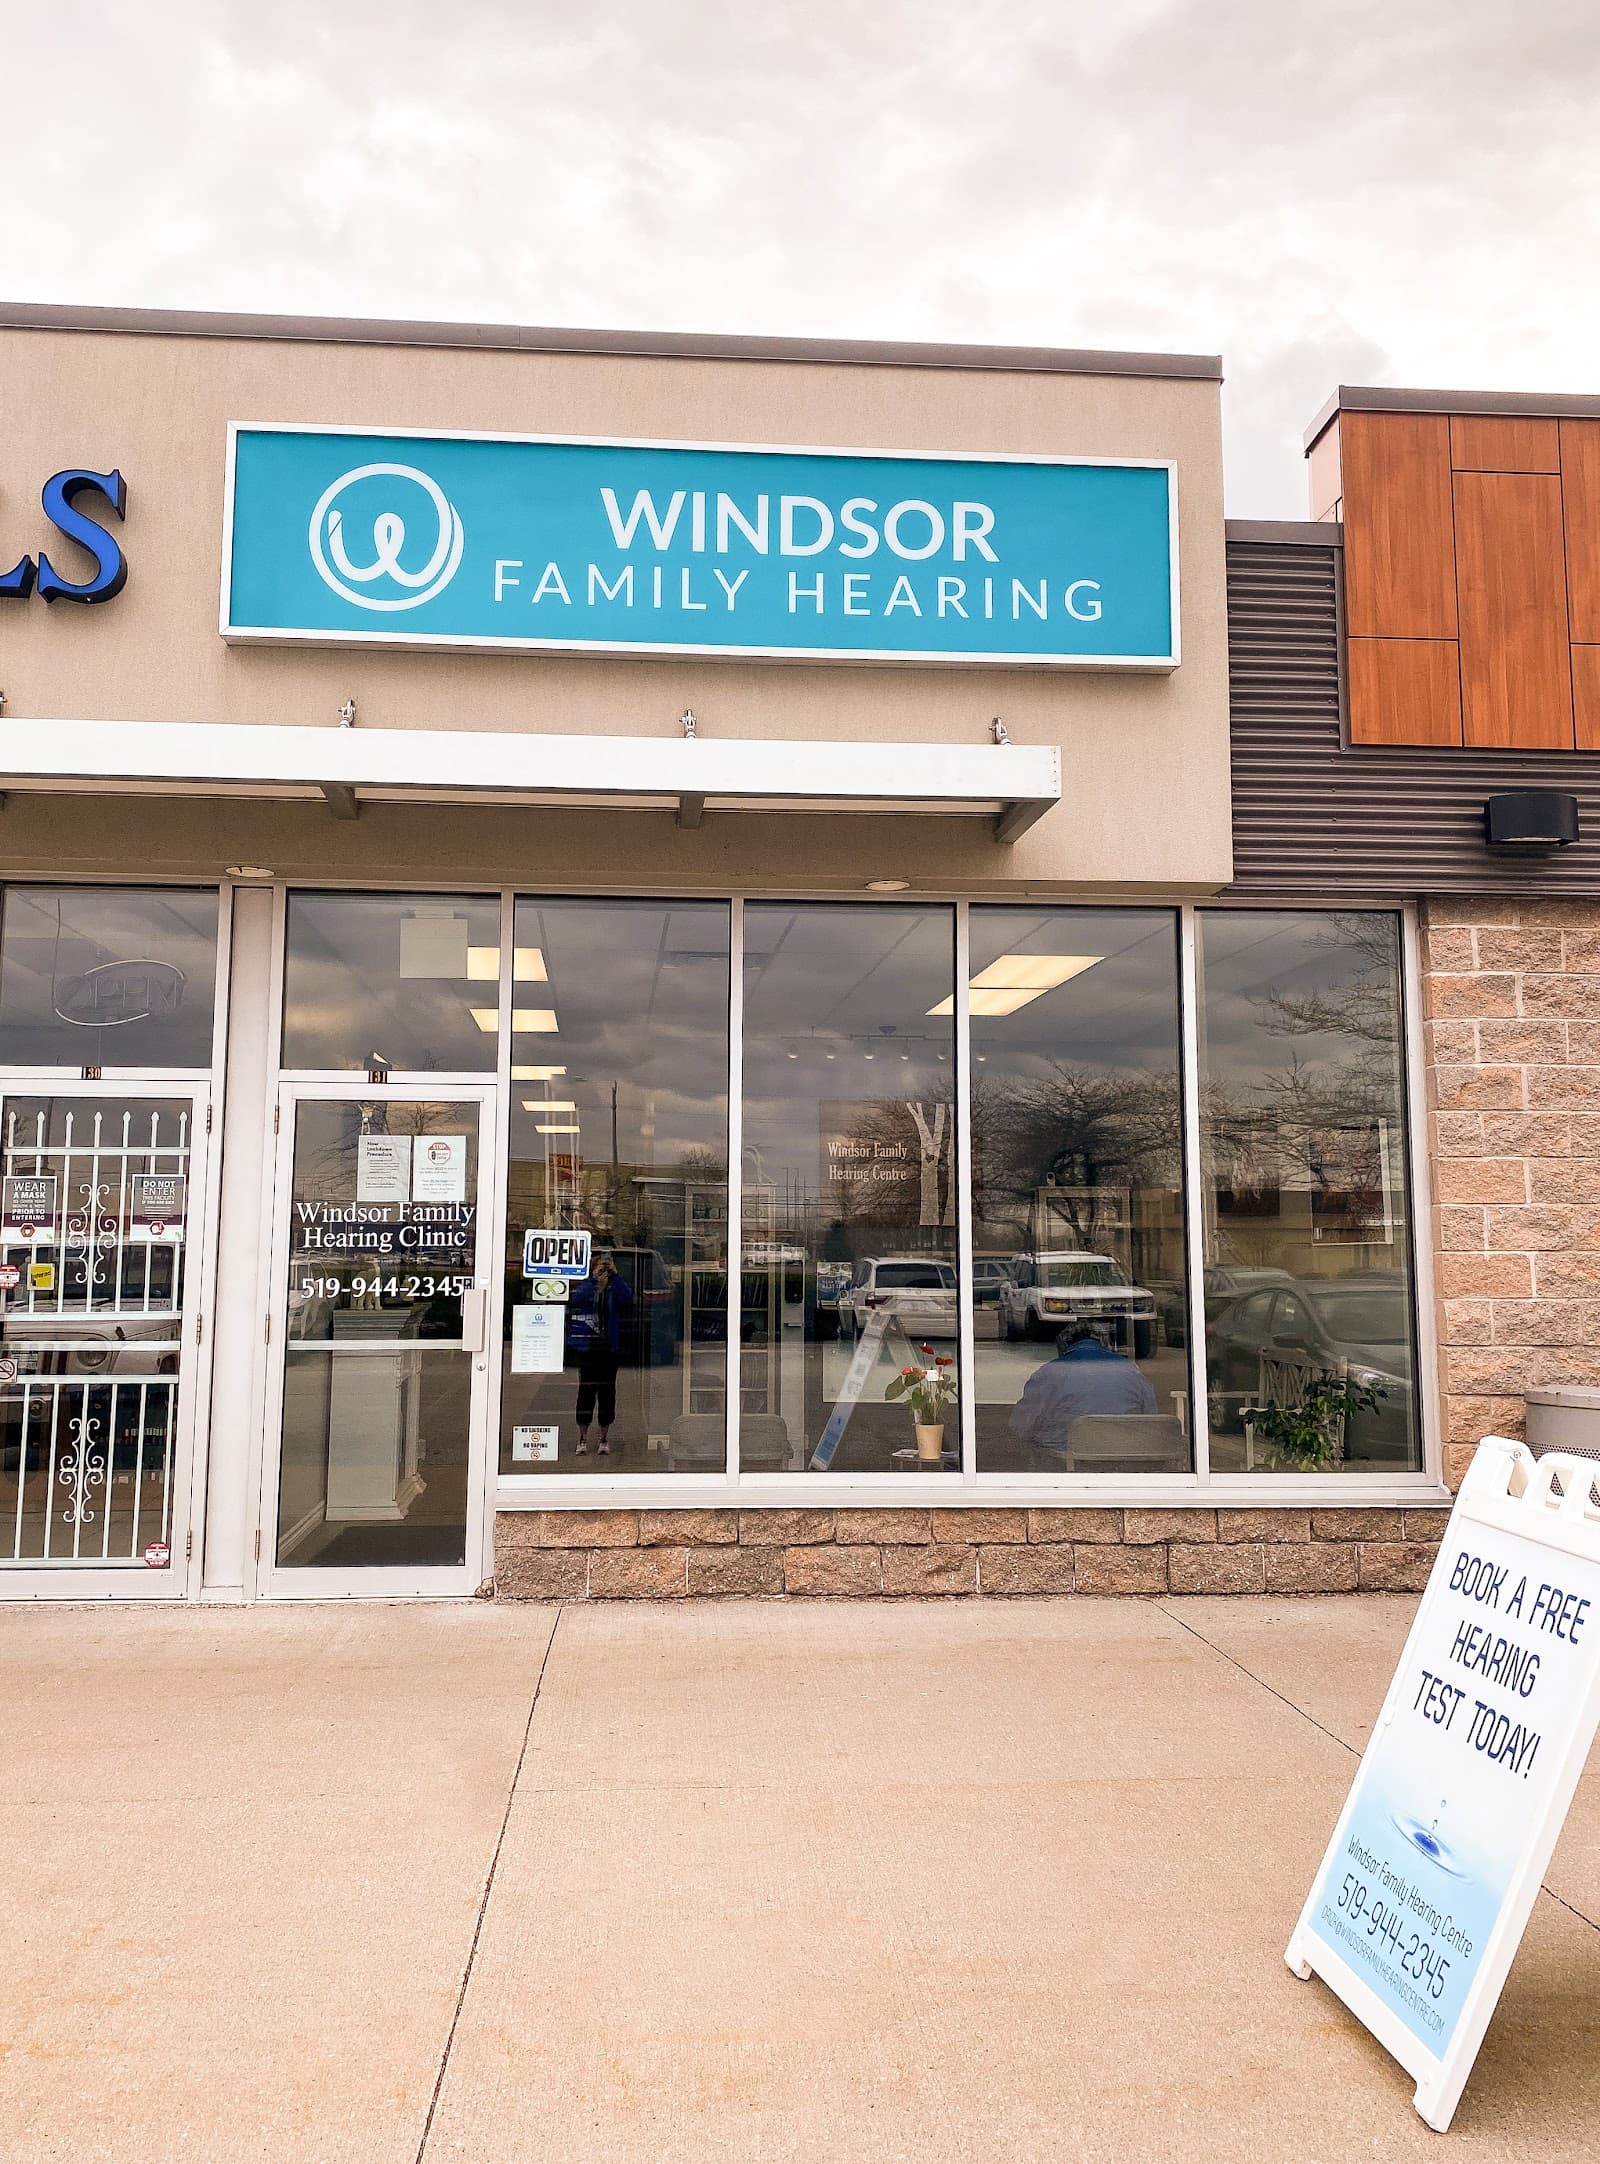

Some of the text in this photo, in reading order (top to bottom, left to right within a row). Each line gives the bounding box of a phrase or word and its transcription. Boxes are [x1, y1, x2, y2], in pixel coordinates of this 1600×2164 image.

[600, 487, 1000, 563] WINDSOR
[493, 559, 1104, 622] FAMILY HEARING
[81, 1067, 101, 1080] 130
[828, 1142, 908, 1159] Windsor Family
[14, 1182, 46, 1191] WEAR
[829, 1165, 907, 1182] Hearing Centre
[143, 1188, 176, 1196] ENTER
[296, 1201, 475, 1227] Windsor Family
[303, 1226, 466, 1251] Hearing Clinic
[531, 1237, 585, 1265] OPEN
[300, 1276, 464, 1298] 519-944-2345
[1449, 1552, 1591, 1645] BOOK A FREE
[1449, 1620, 1541, 1698] HEARING
[1413, 1670, 1541, 1779] TEST TODAY!
[1348, 1834, 1473, 1959] Windsor Family Hearing Centre
[1338, 1872, 1450, 1999] 519-944-2345
